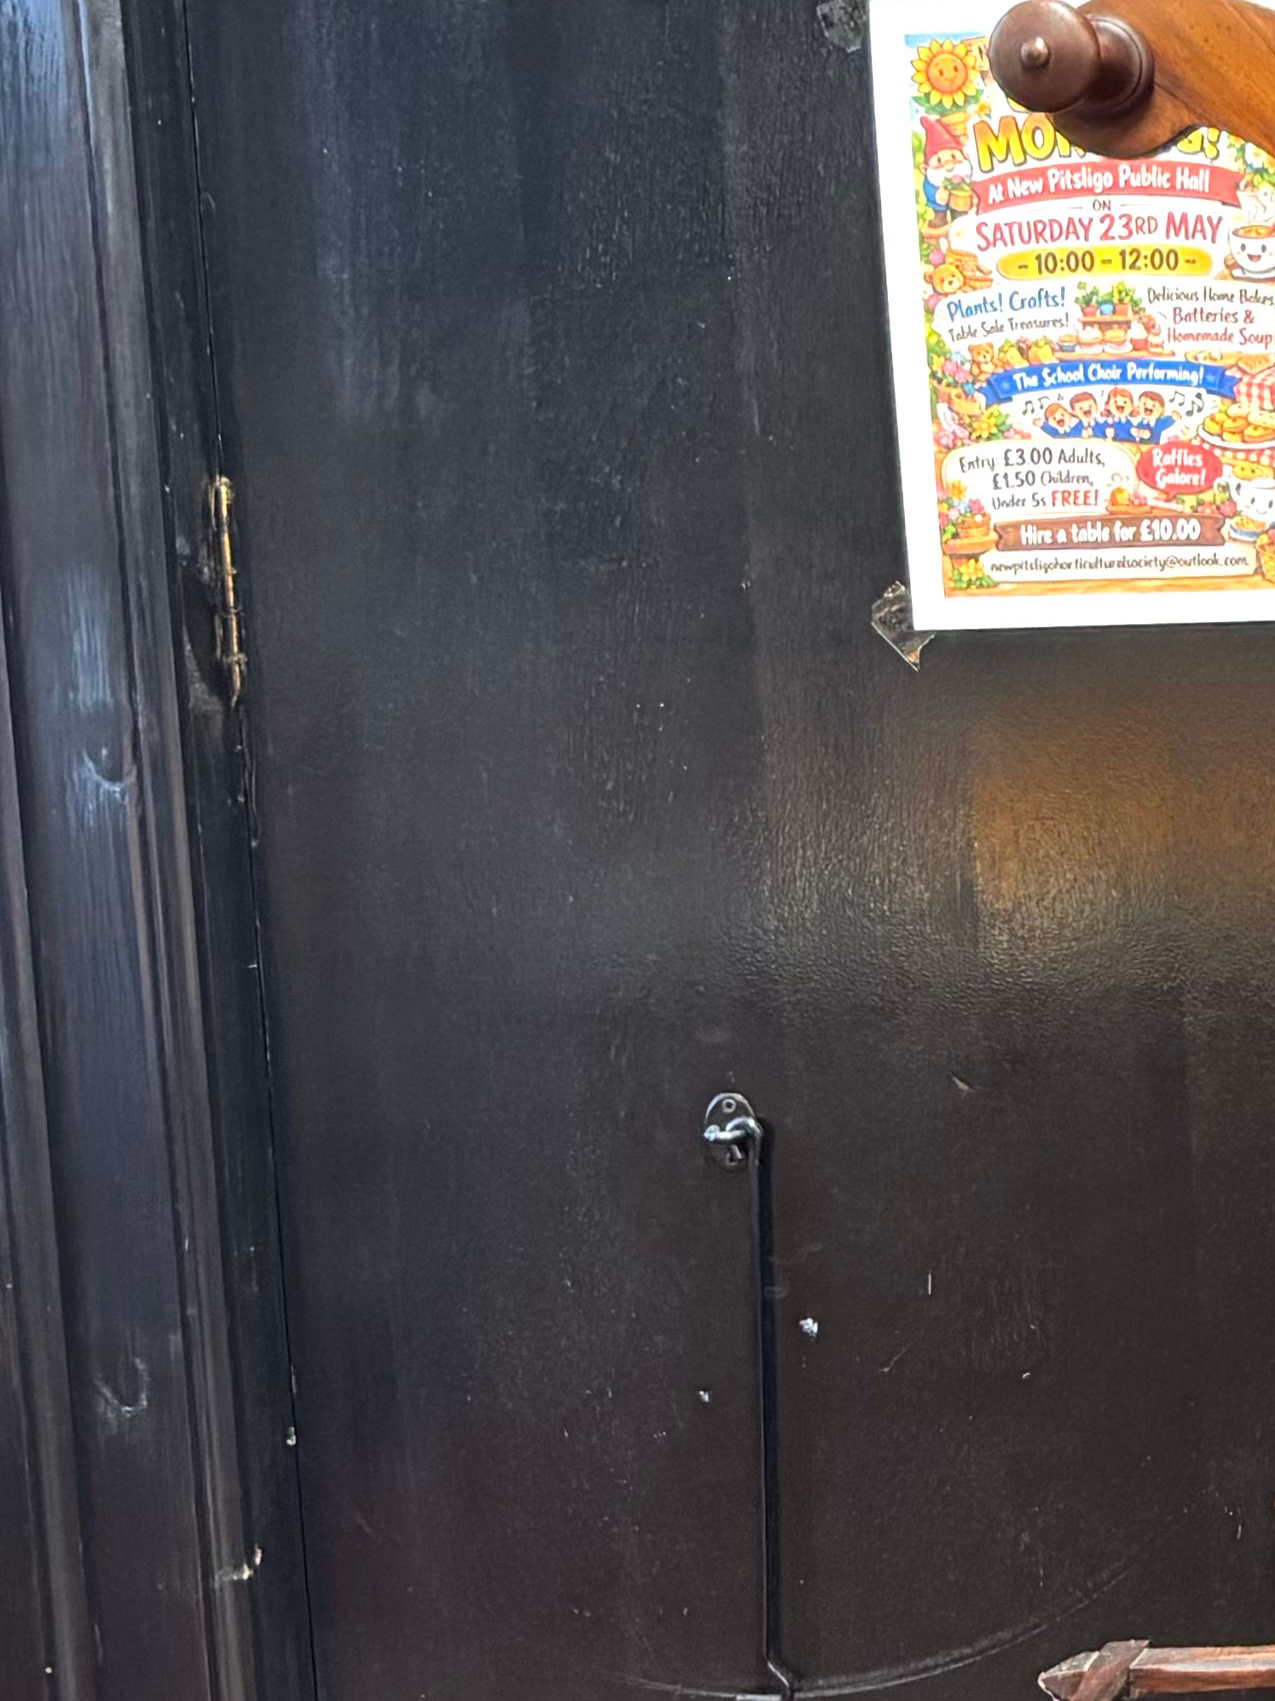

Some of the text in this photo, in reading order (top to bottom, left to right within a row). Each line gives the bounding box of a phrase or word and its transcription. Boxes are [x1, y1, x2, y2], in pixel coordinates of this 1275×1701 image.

[988, 164, 1210, 205] At New Pitsligo Public Hall
[1092, 198, 1112, 212] ON
[975, 211, 1223, 252] SATURDAY 23RD MAY
[1035, 250, 1095, 275] 10:00
[1119, 248, 1179, 271] 12:00
[947, 286, 1065, 322] Plants! Crafts!
[1147, 286, 1199, 304] Delicious
[1204, 285, 1234, 303] Home
[948, 312, 1069, 342] Table Sale Treasures!
[1243, 309, 1255, 324] &
[1167, 326, 1234, 343] Homemade
[1013, 361, 1205, 391] The School Choir Performing!
[1003, 447, 1053, 467] £3.00
[1057, 448, 1106, 468] Adults,
[1152, 447, 1203, 468] Raffles
[992, 470, 1094, 490] £1.50 Children,
[1155, 467, 1206, 489] Galore!
[992, 489, 1099, 510] Under 5s FREE!
[1020, 517, 1201, 546] Hire a table for £10.00
